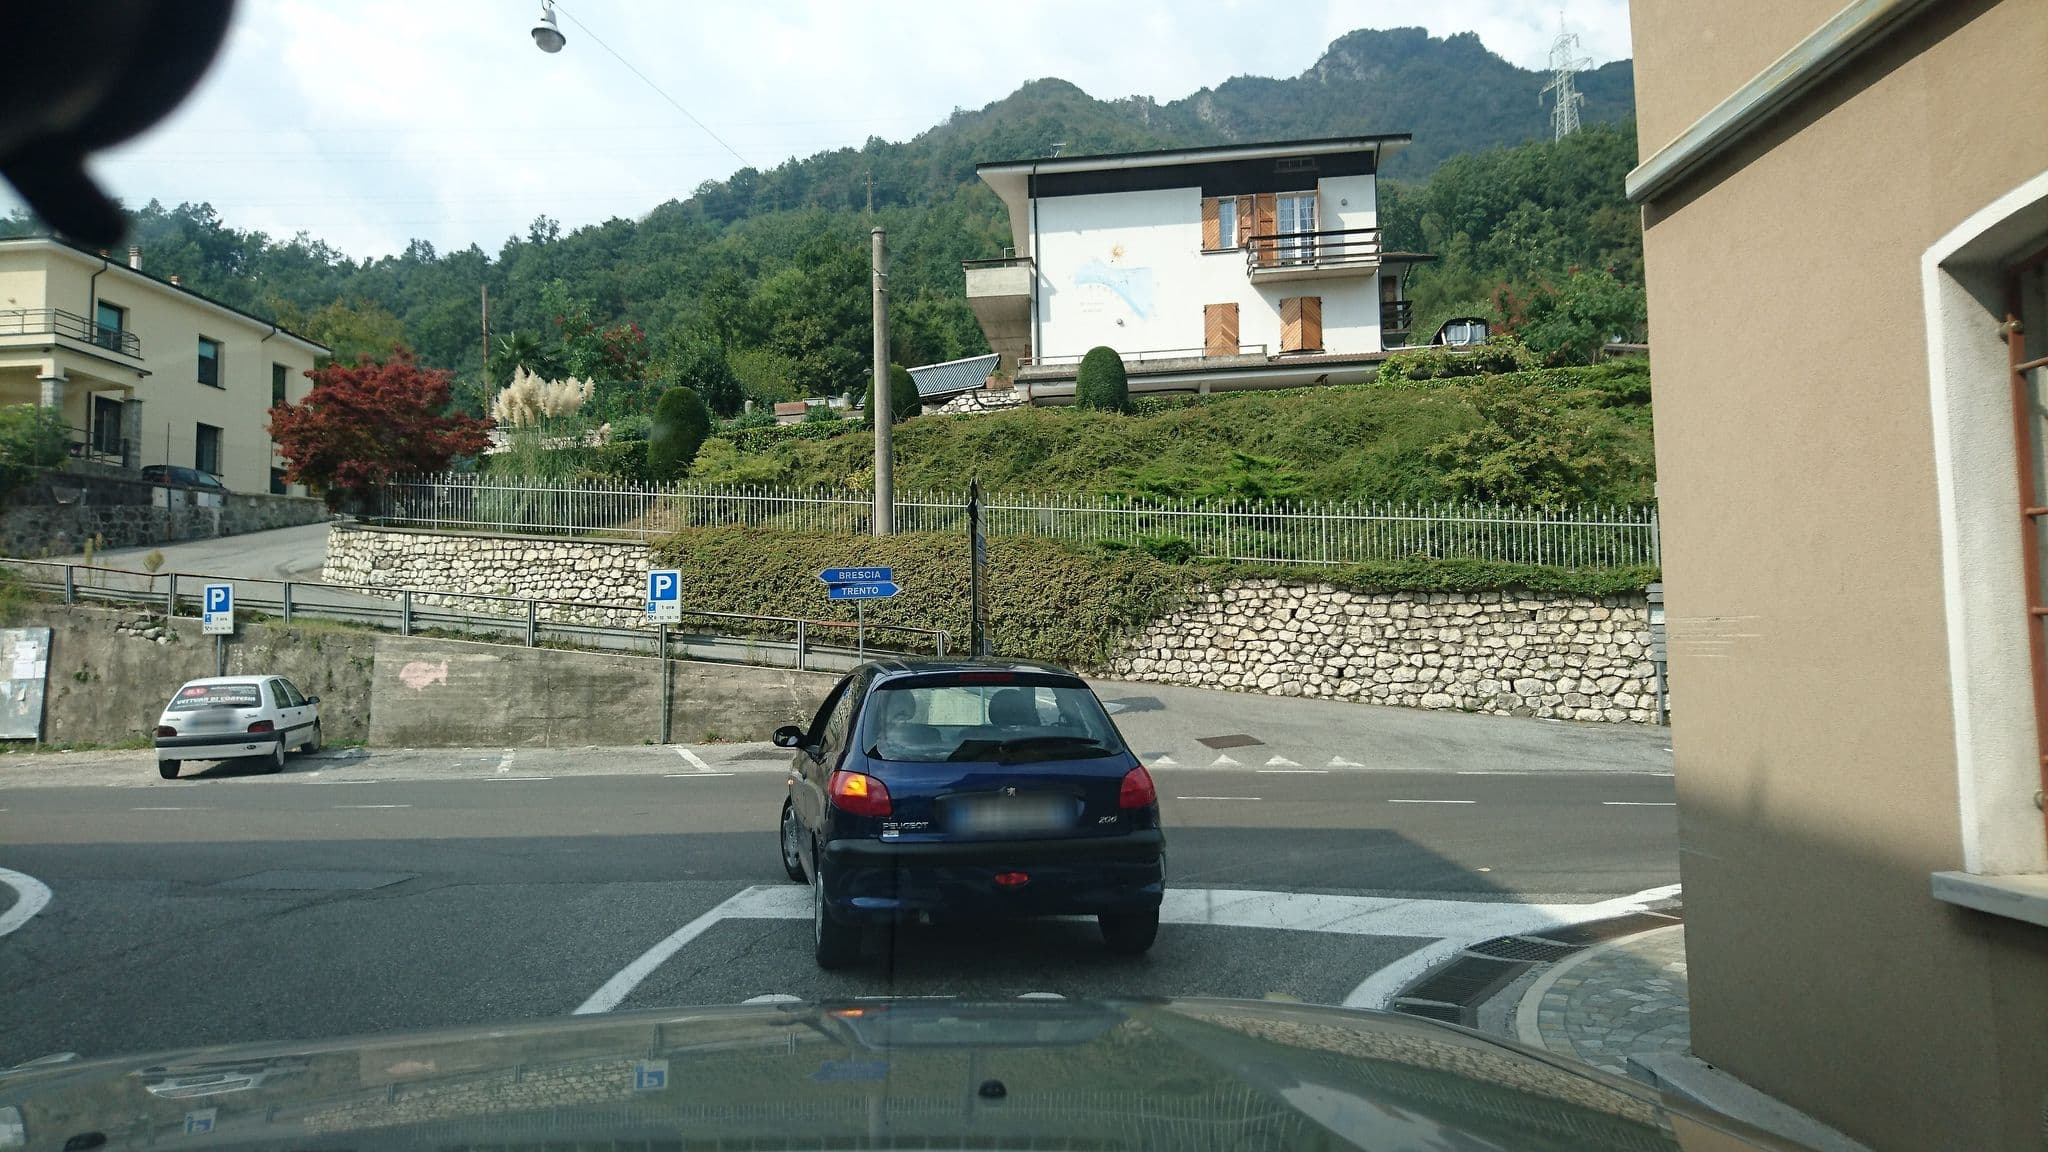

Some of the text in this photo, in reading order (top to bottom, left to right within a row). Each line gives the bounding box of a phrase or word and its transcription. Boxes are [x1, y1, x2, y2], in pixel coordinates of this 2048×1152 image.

[839, 571, 881, 579] BRESCIA
[656, 575, 672, 598] P
[842, 587, 879, 595] TRENTO
[211, 589, 225, 610] P
[882, 822, 929, 830] PEUGEOT
